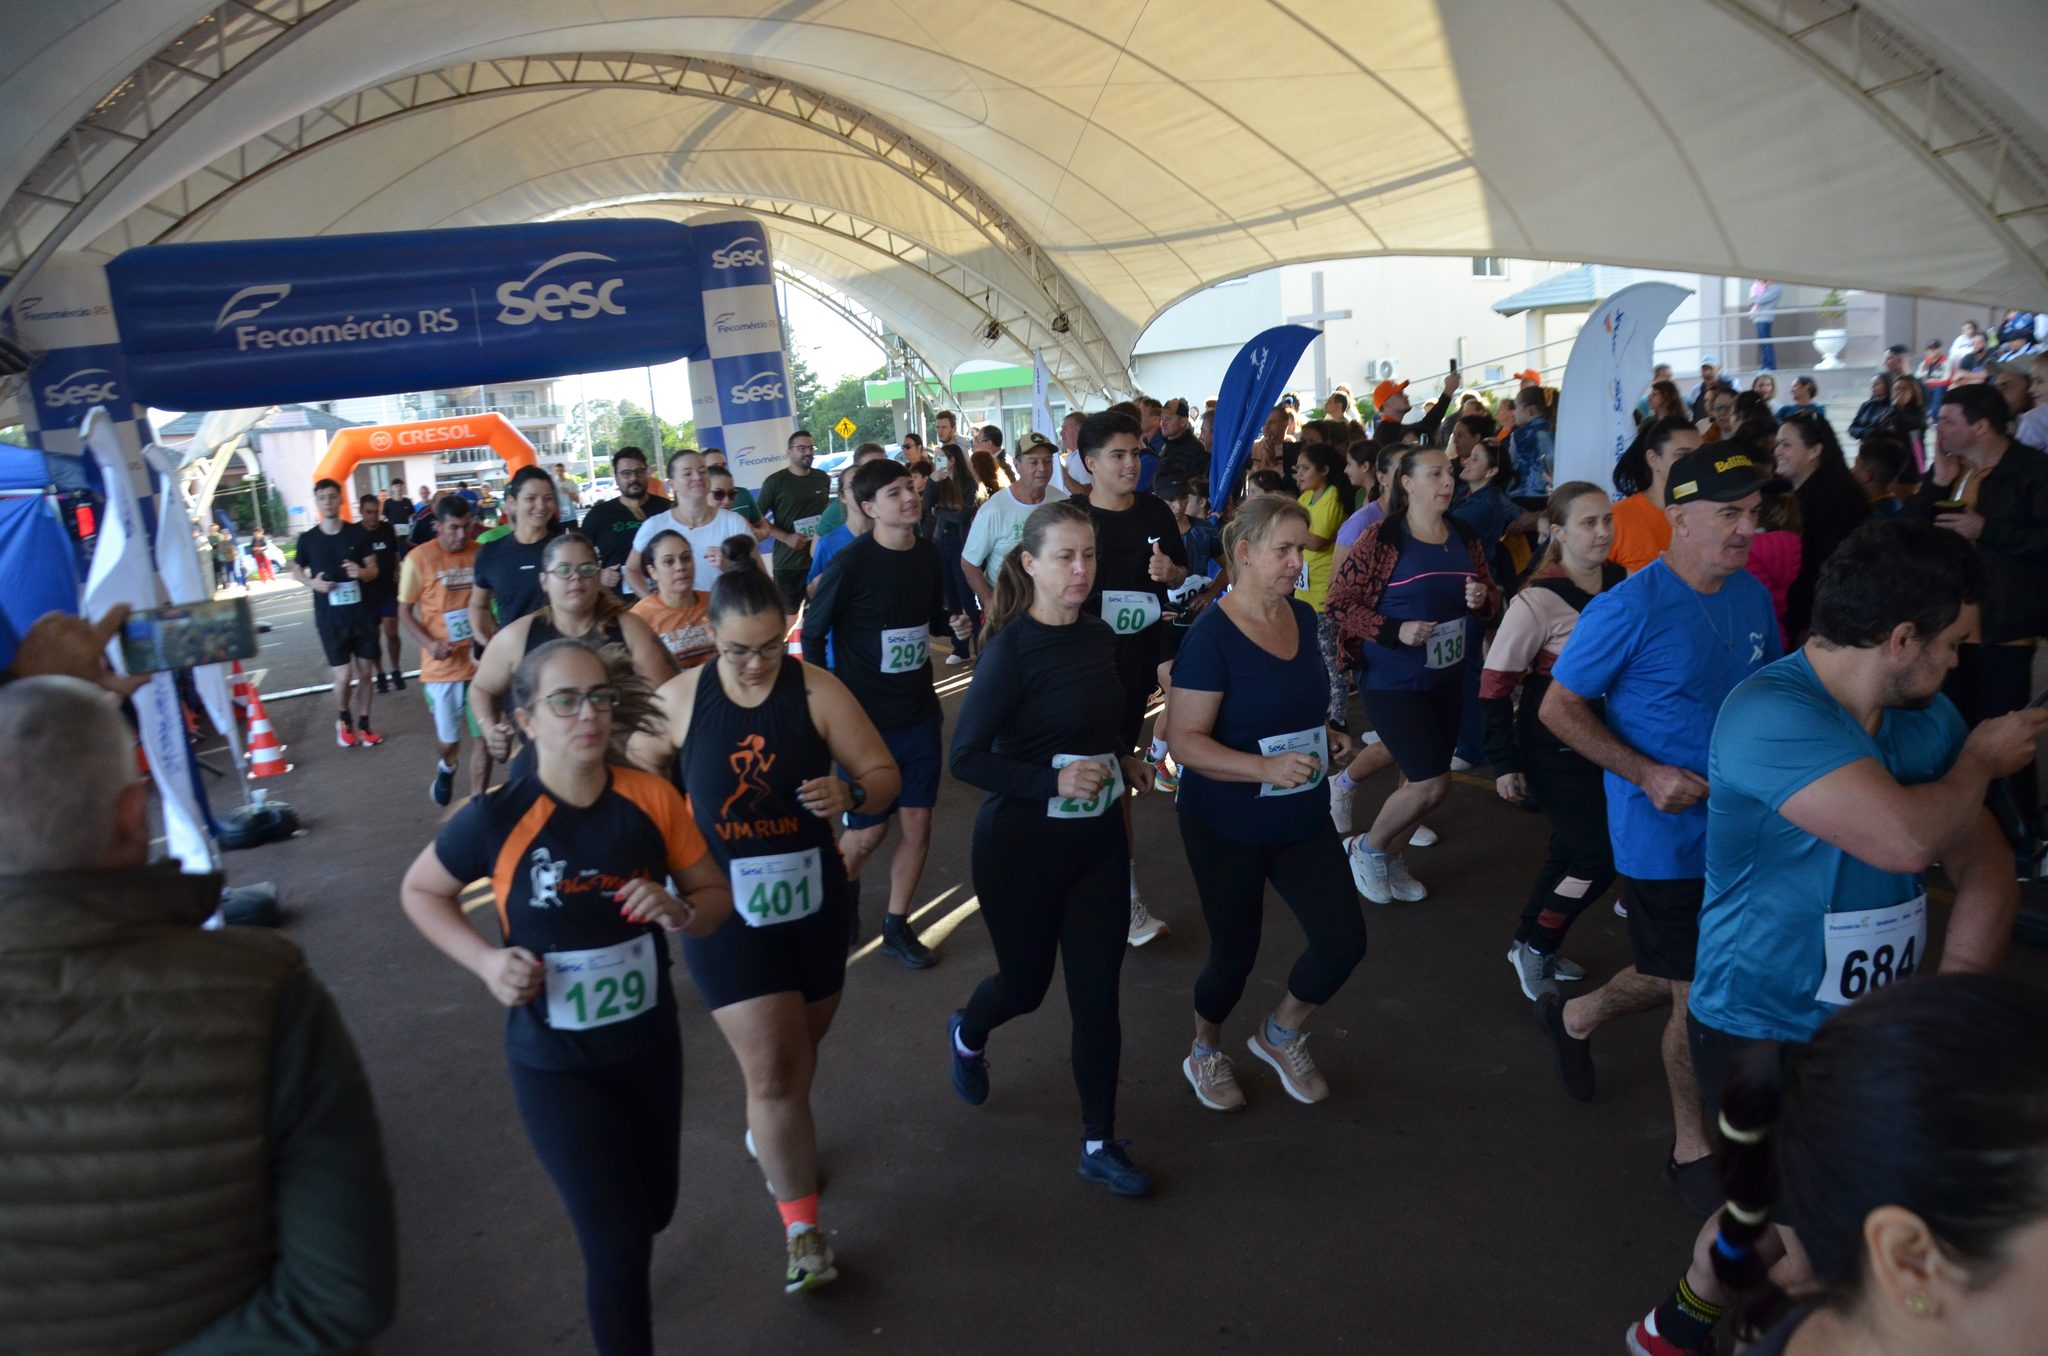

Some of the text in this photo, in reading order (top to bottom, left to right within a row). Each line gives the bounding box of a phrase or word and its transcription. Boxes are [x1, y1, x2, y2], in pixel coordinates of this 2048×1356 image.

[712, 243, 765, 270] Sesc
[496, 264, 627, 326] Sesc
[237, 308, 459, 351] Fecomércio RS
[717, 320, 768, 334] Fecomércio
[44, 376, 119, 407] Sesc
[731, 377, 784, 405] Sesc
[397, 423, 476, 446] CRESOL
[1117, 608, 1146, 631] 60
[890, 640, 926, 669] 292
[1433, 634, 1463, 666] 138
[1268, 741, 1286, 753] Sesc
[715, 816, 799, 841] VM RUN
[747, 875, 810, 918] 401
[1840, 935, 1916, 1000] 684
[565, 969, 645, 1023] 129
